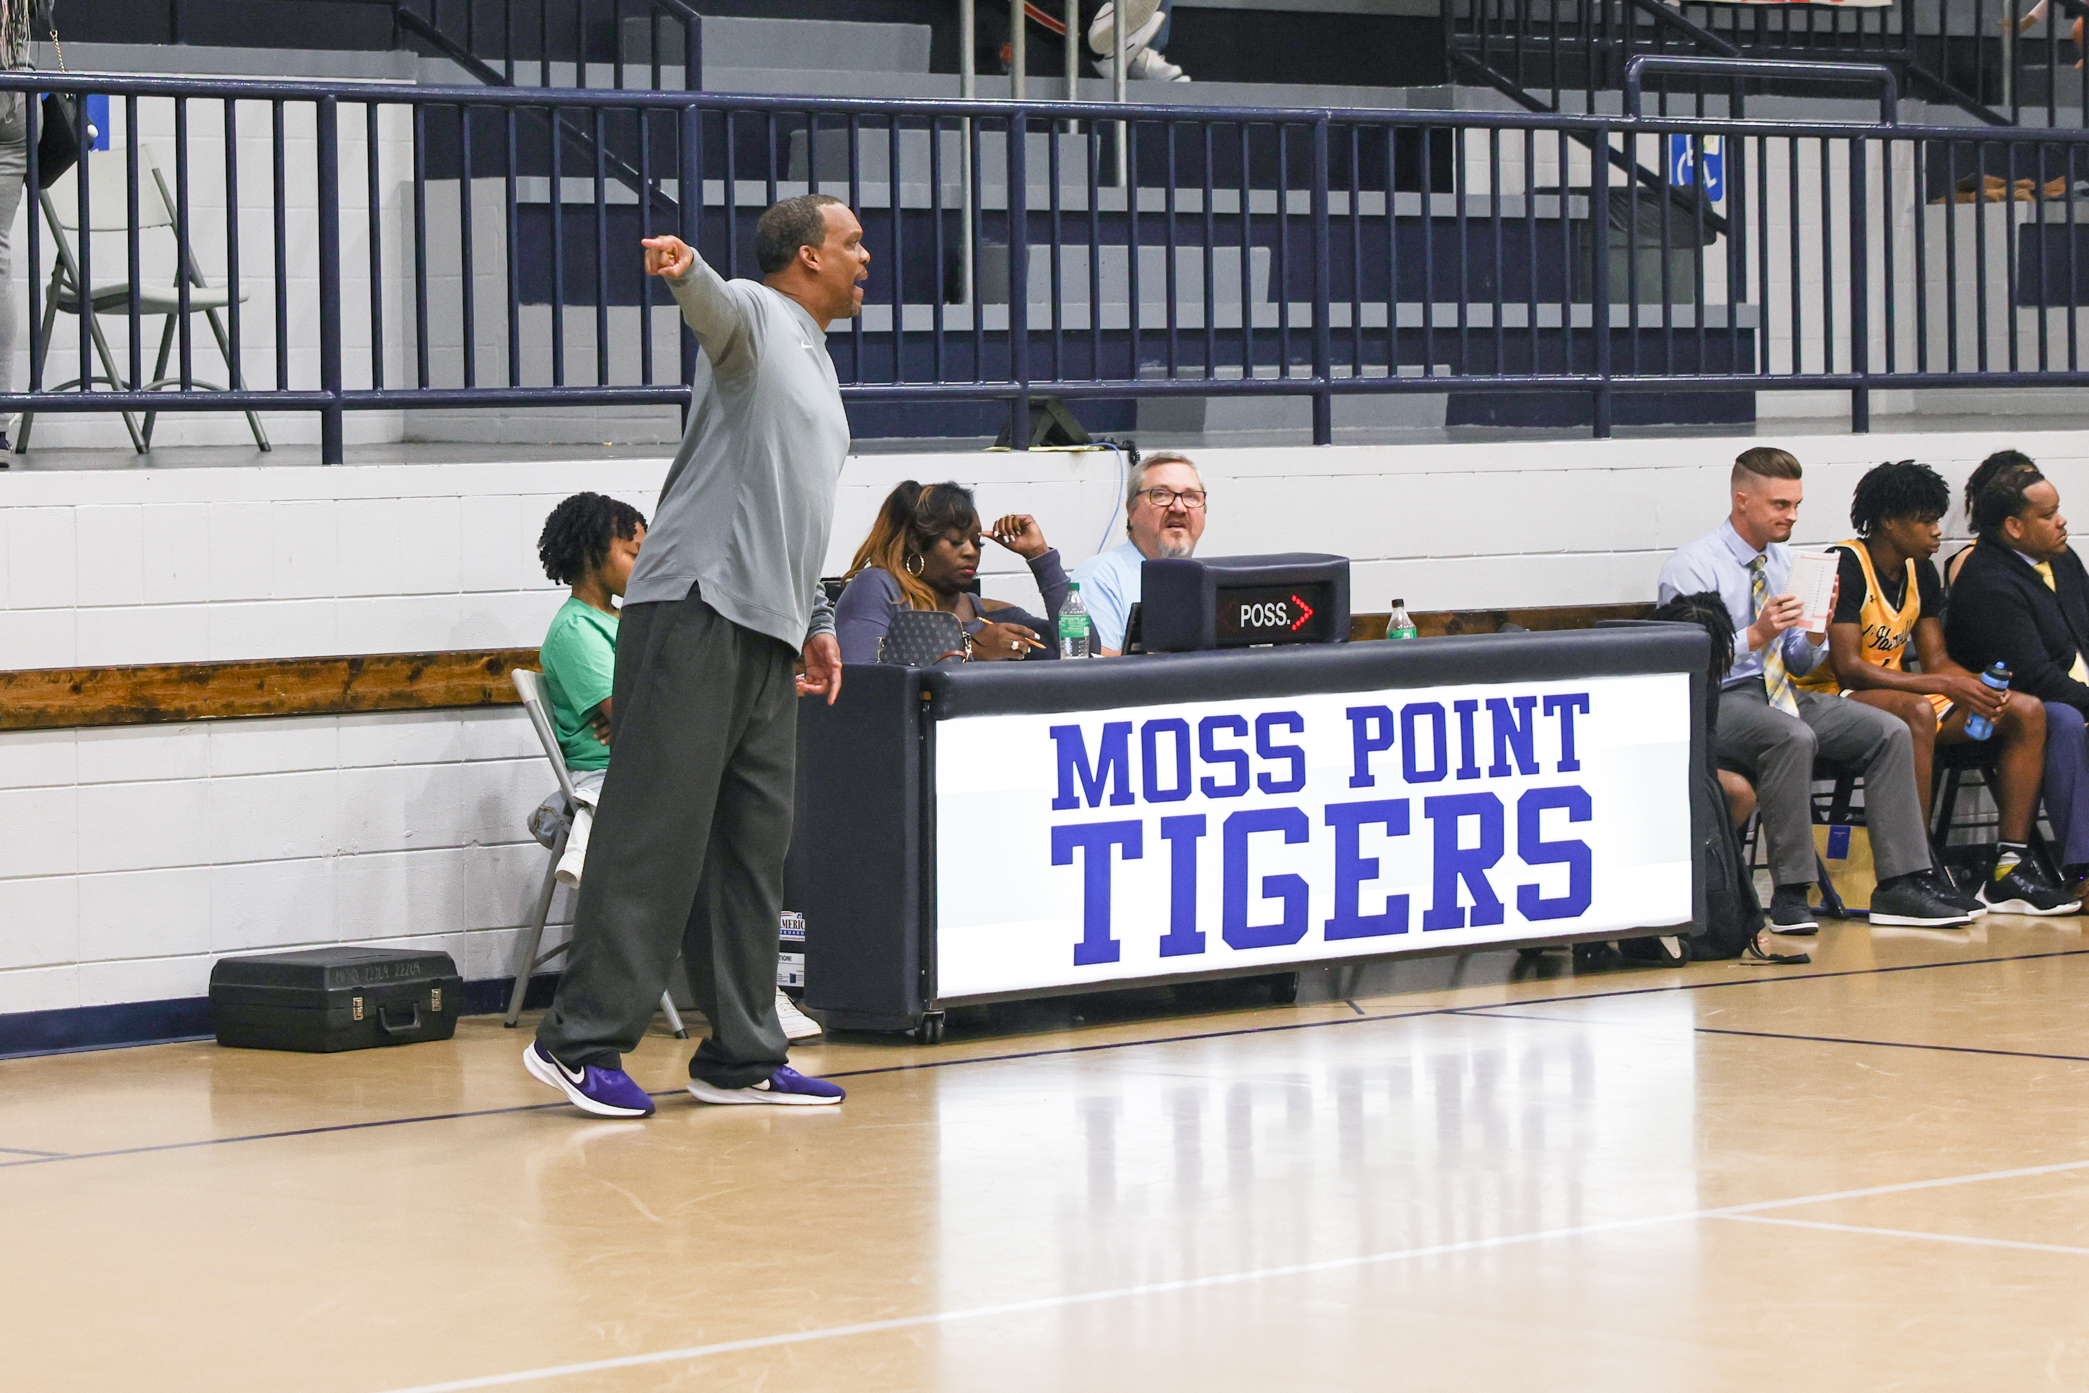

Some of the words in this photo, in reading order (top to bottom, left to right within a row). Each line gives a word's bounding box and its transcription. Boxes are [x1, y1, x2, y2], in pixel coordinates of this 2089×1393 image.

[1239, 602, 1291, 628] POSS.
[1049, 710, 1306, 811] MOSS
[1345, 692, 1590, 789] POINT
[1050, 784, 1593, 967] TIGERS
[781, 918, 805, 930] MERIC
